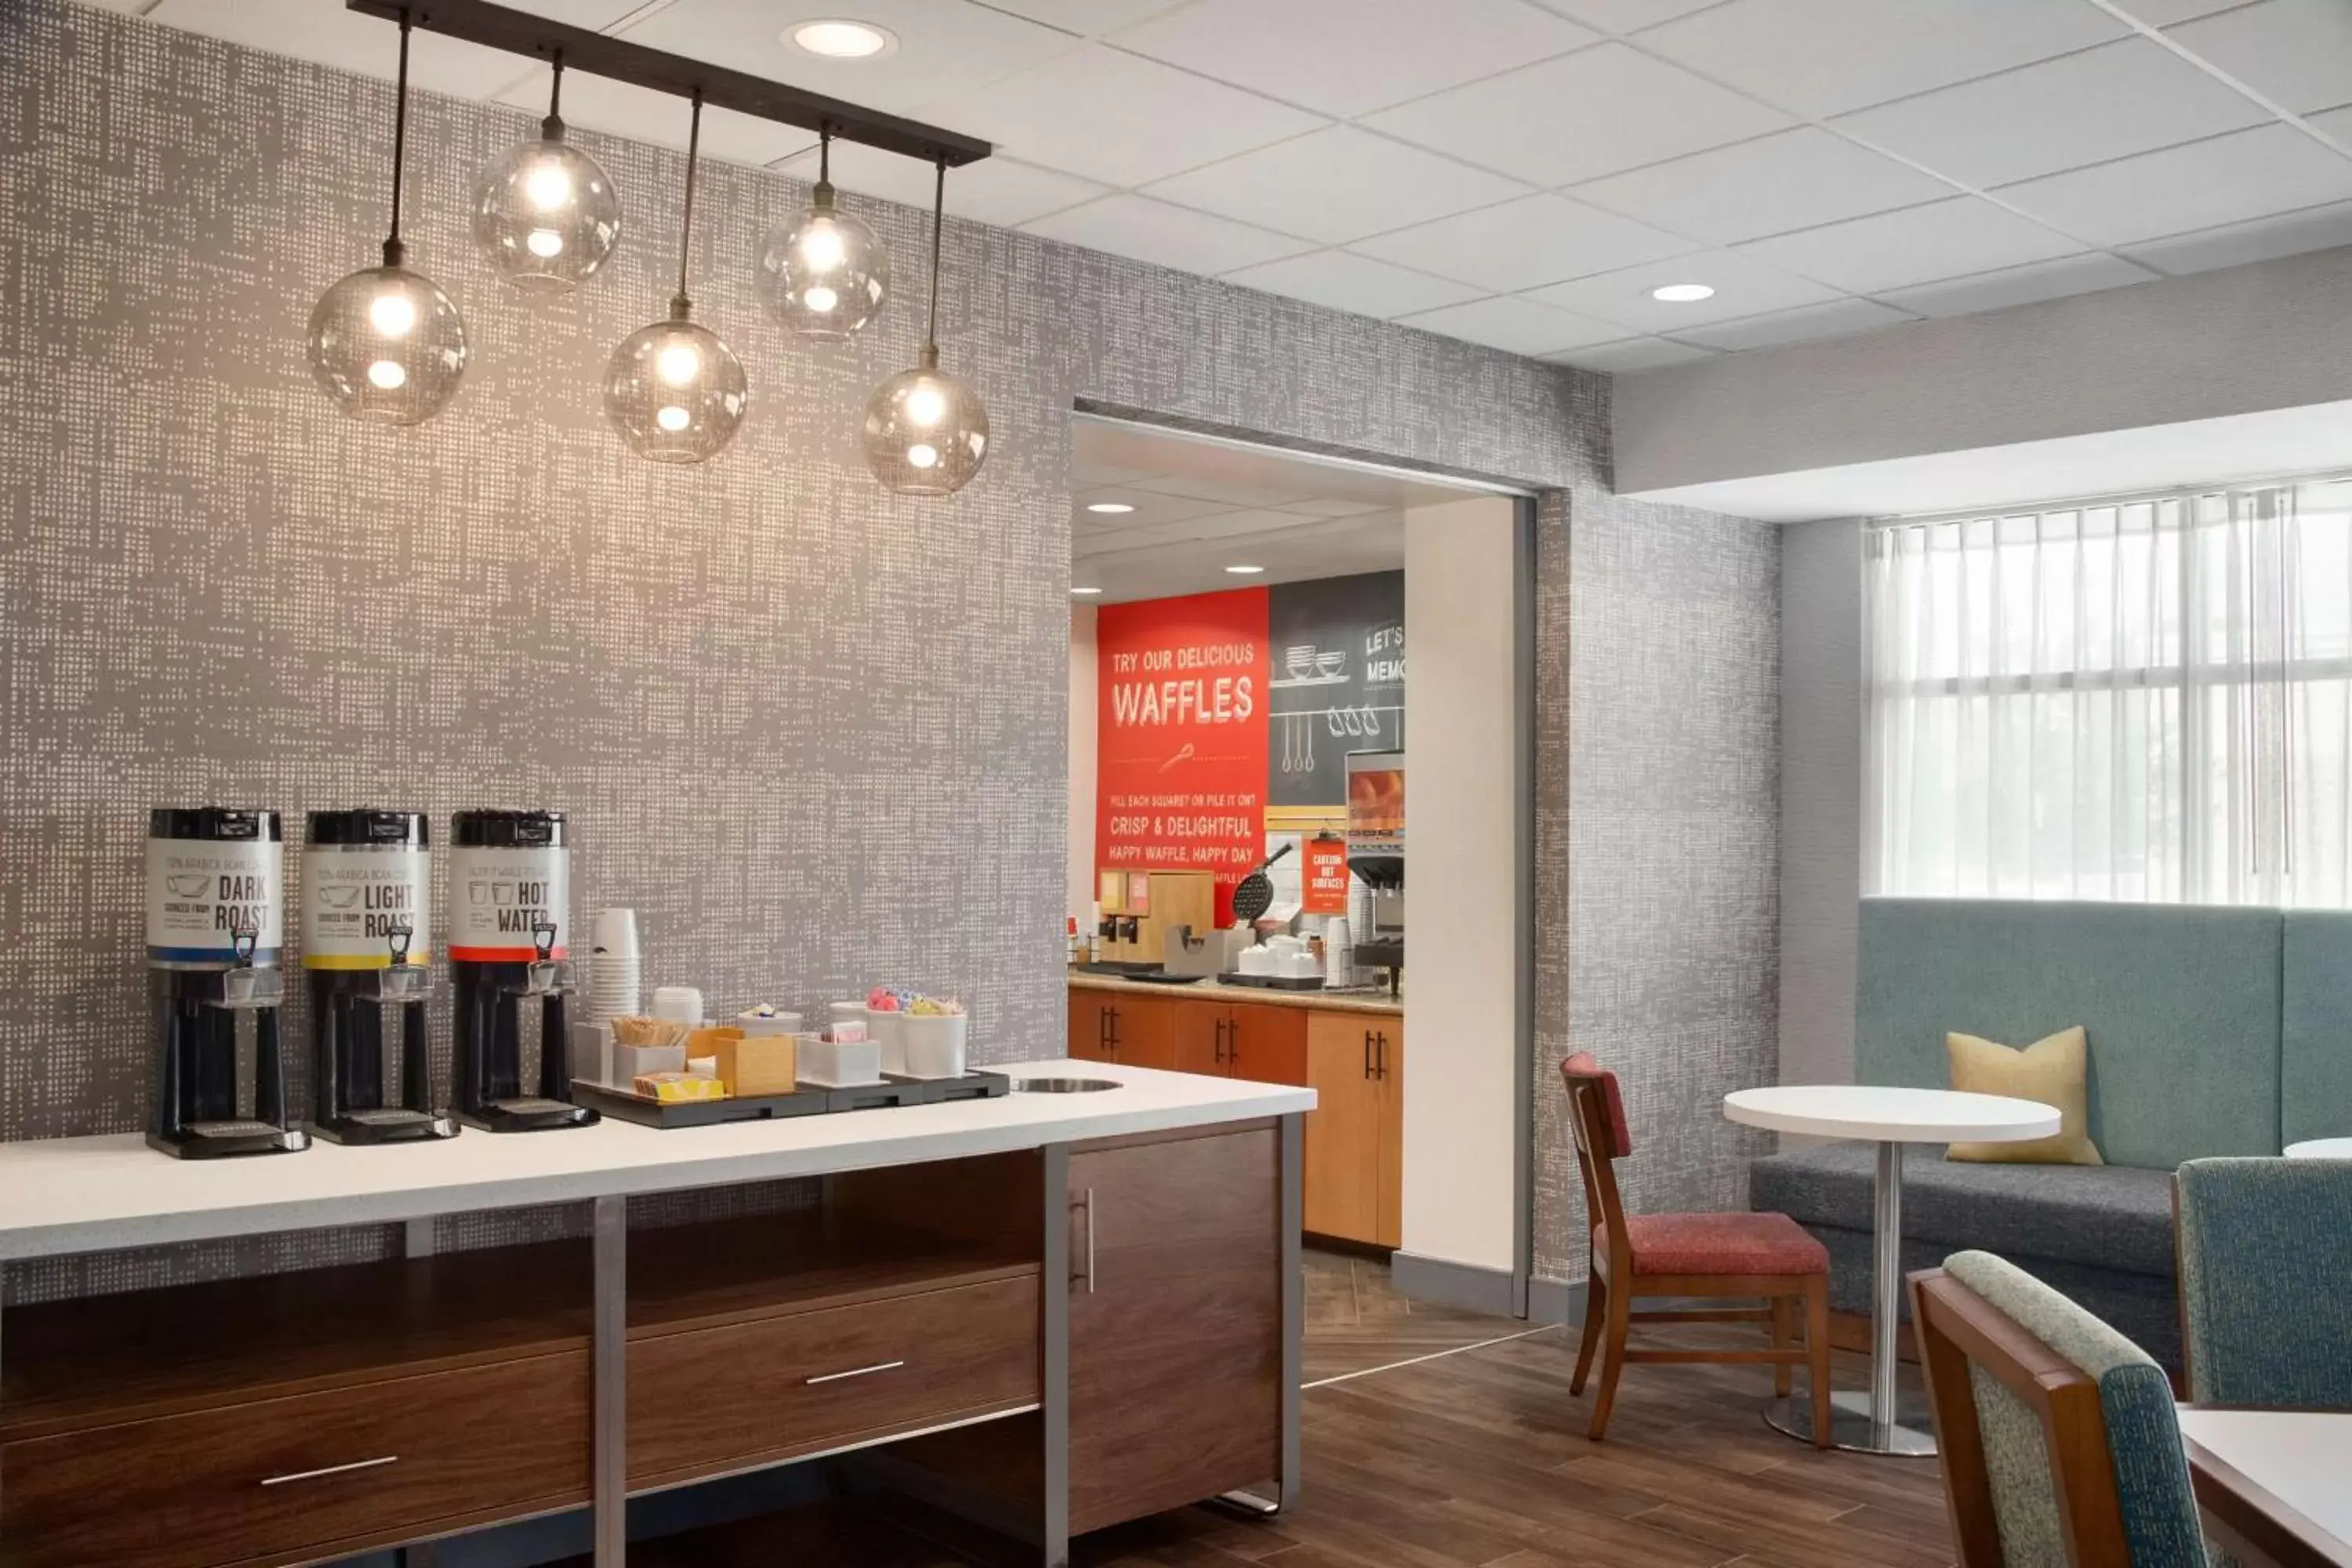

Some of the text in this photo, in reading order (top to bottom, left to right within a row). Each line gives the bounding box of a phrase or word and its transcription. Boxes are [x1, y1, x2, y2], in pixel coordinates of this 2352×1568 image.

[1367, 626, 1403, 656] LET'S
[1113, 643, 1254, 674] TRY OUR DELICIOUS
[1112, 675, 1253, 728] WAFFLES
[1128, 794, 1149, 807] EACH
[1191, 793, 1204, 807] OR
[1207, 793, 1226, 807] PILE
[1227, 794, 1236, 807] IT
[1110, 815, 1252, 837] CRISP & DELIGHTFUL
[1109, 846, 1254, 862] HAPPY WAFFLE, HAPPY DAY
[219, 876, 267, 901] DARK
[365, 885, 414, 909] LIGHT
[519, 882, 549, 905] HOT
[215, 905, 269, 930] ROAST
[499, 909, 548, 931] WATER
